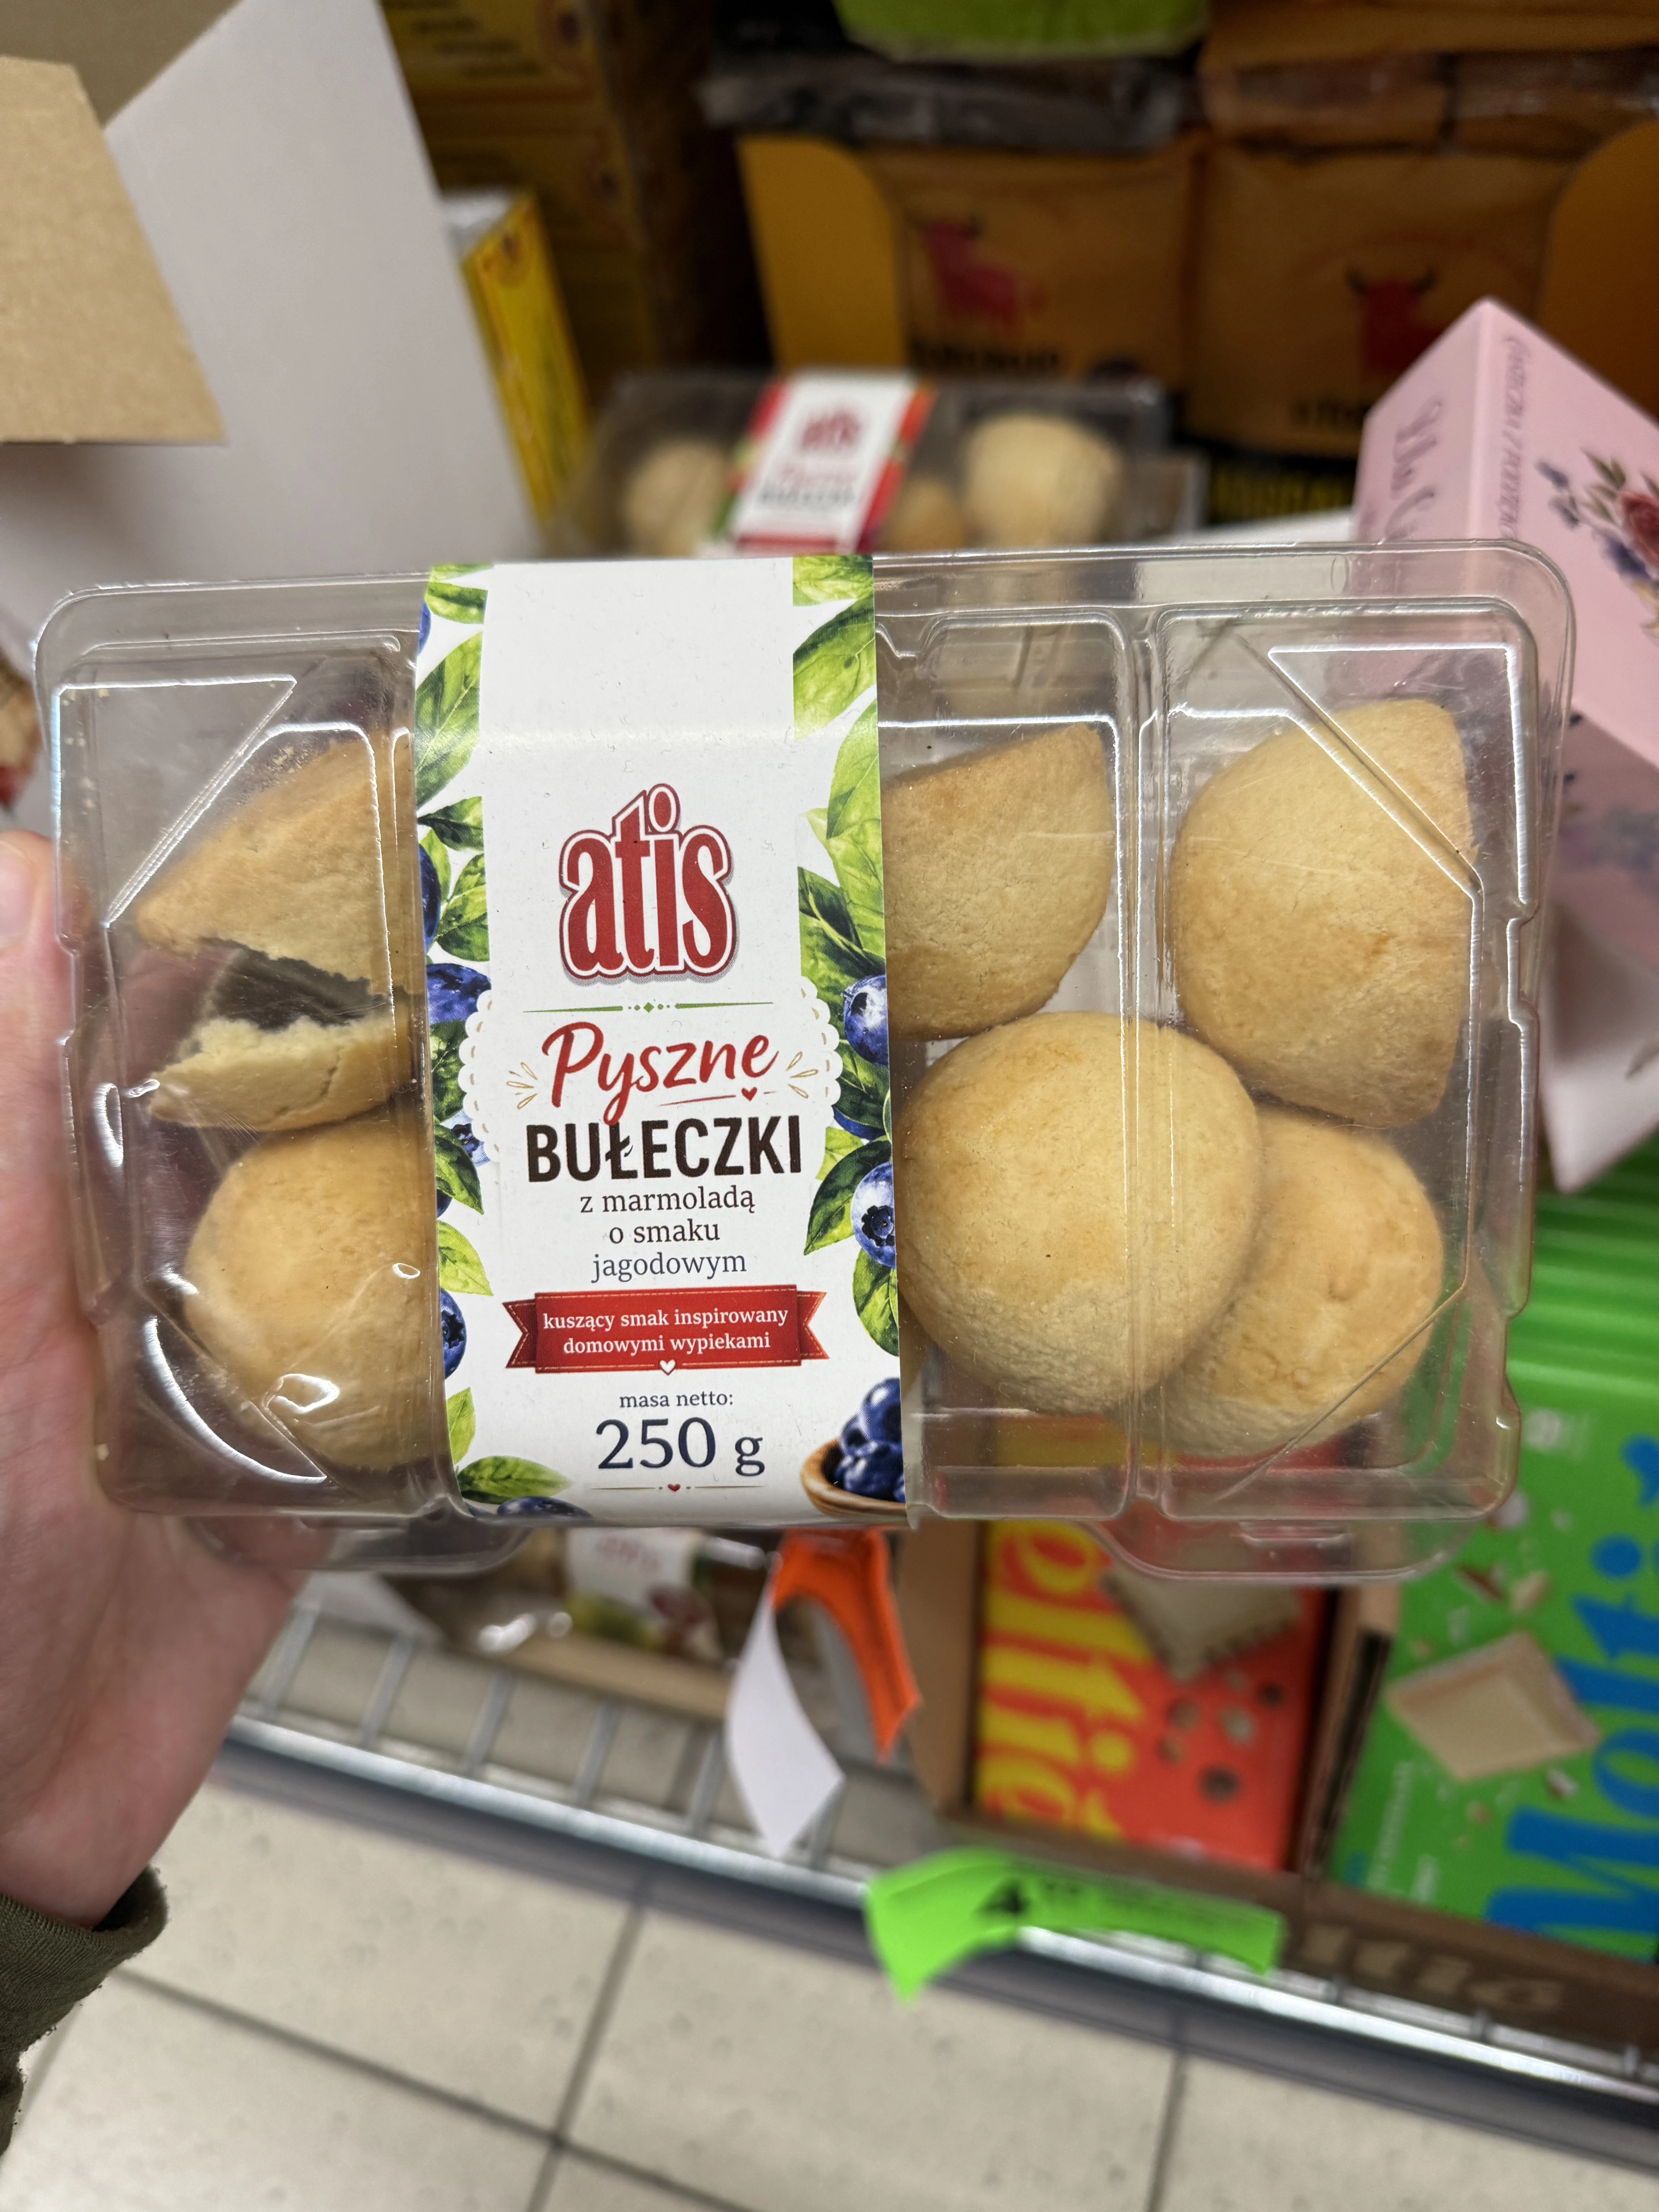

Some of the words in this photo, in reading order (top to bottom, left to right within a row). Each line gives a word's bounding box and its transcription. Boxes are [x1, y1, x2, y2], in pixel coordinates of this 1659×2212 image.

[558, 783, 740, 987] atis
[542, 1021, 779, 1126] Pyszne
[526, 1115, 801, 1182] BUŁECZKI
[580, 1195, 593, 1213] z
[602, 1185, 755, 1214] marmoladą
[609, 1227, 624, 1244] o
[633, 1219, 720, 1243] smaku
[591, 1252, 747, 1283] jagodowym
[543, 1313, 615, 1332] kuszący
[620, 1310, 669, 1328] smak
[674, 1308, 788, 1328] inspirowany
[563, 1335, 665, 1356] domowymi
[670, 1332, 771, 1354] wypiekami
[620, 1395, 670, 1408] masa
[677, 1391, 733, 1407] netto:
[596, 1417, 716, 1469] 250
[735, 1436, 766, 1477] g
